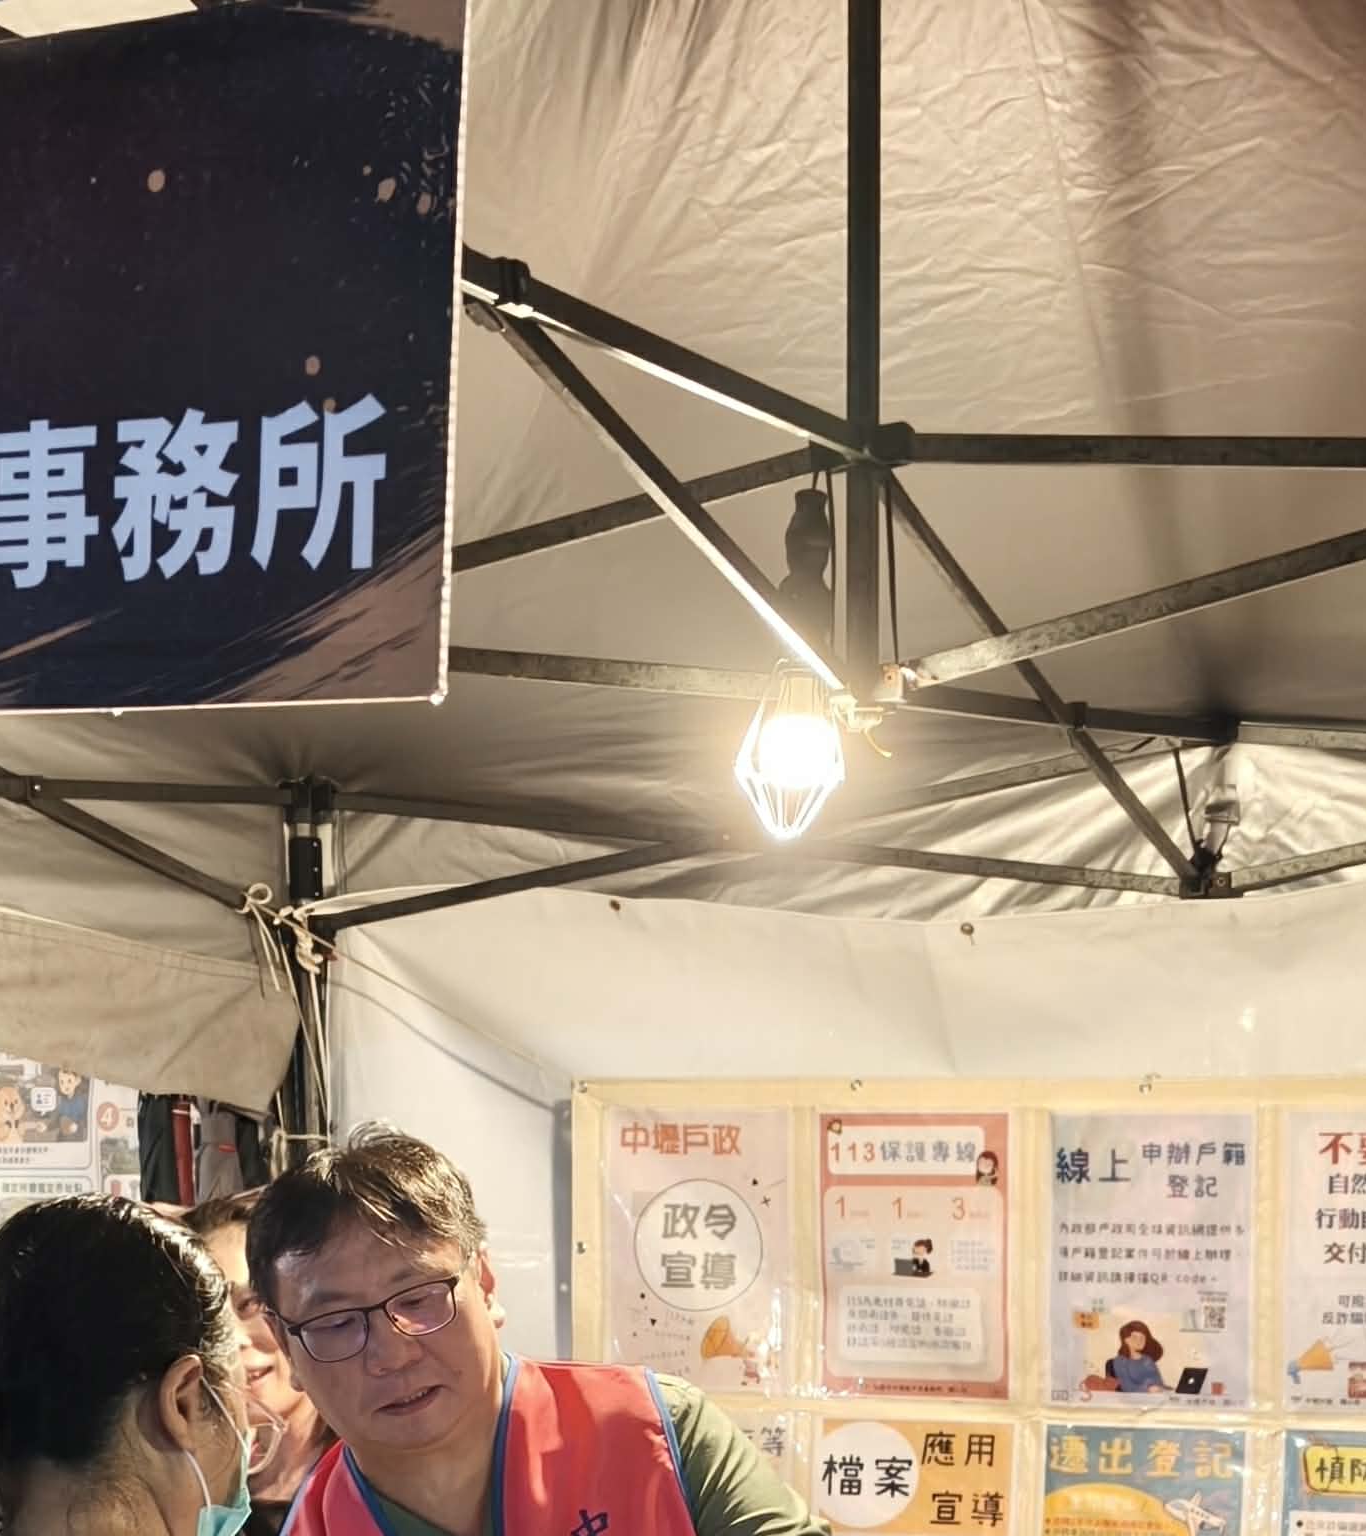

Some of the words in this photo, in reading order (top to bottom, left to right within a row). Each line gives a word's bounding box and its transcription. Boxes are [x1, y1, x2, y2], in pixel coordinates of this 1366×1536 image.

[620, 1120, 742, 1156] 中壢戶政
[1056, 1146, 1131, 1185] 線上
[1166, 1173, 1218, 1199] 登記
[661, 1202, 738, 1241] 政令
[660, 1250, 737, 1290] 宣導
[822, 1453, 914, 1498] 檔案
[921, 1431, 995, 1467] 應用
[1050, 1434, 1235, 1479] 遷出登記
[930, 1490, 1005, 1528] 宣導
